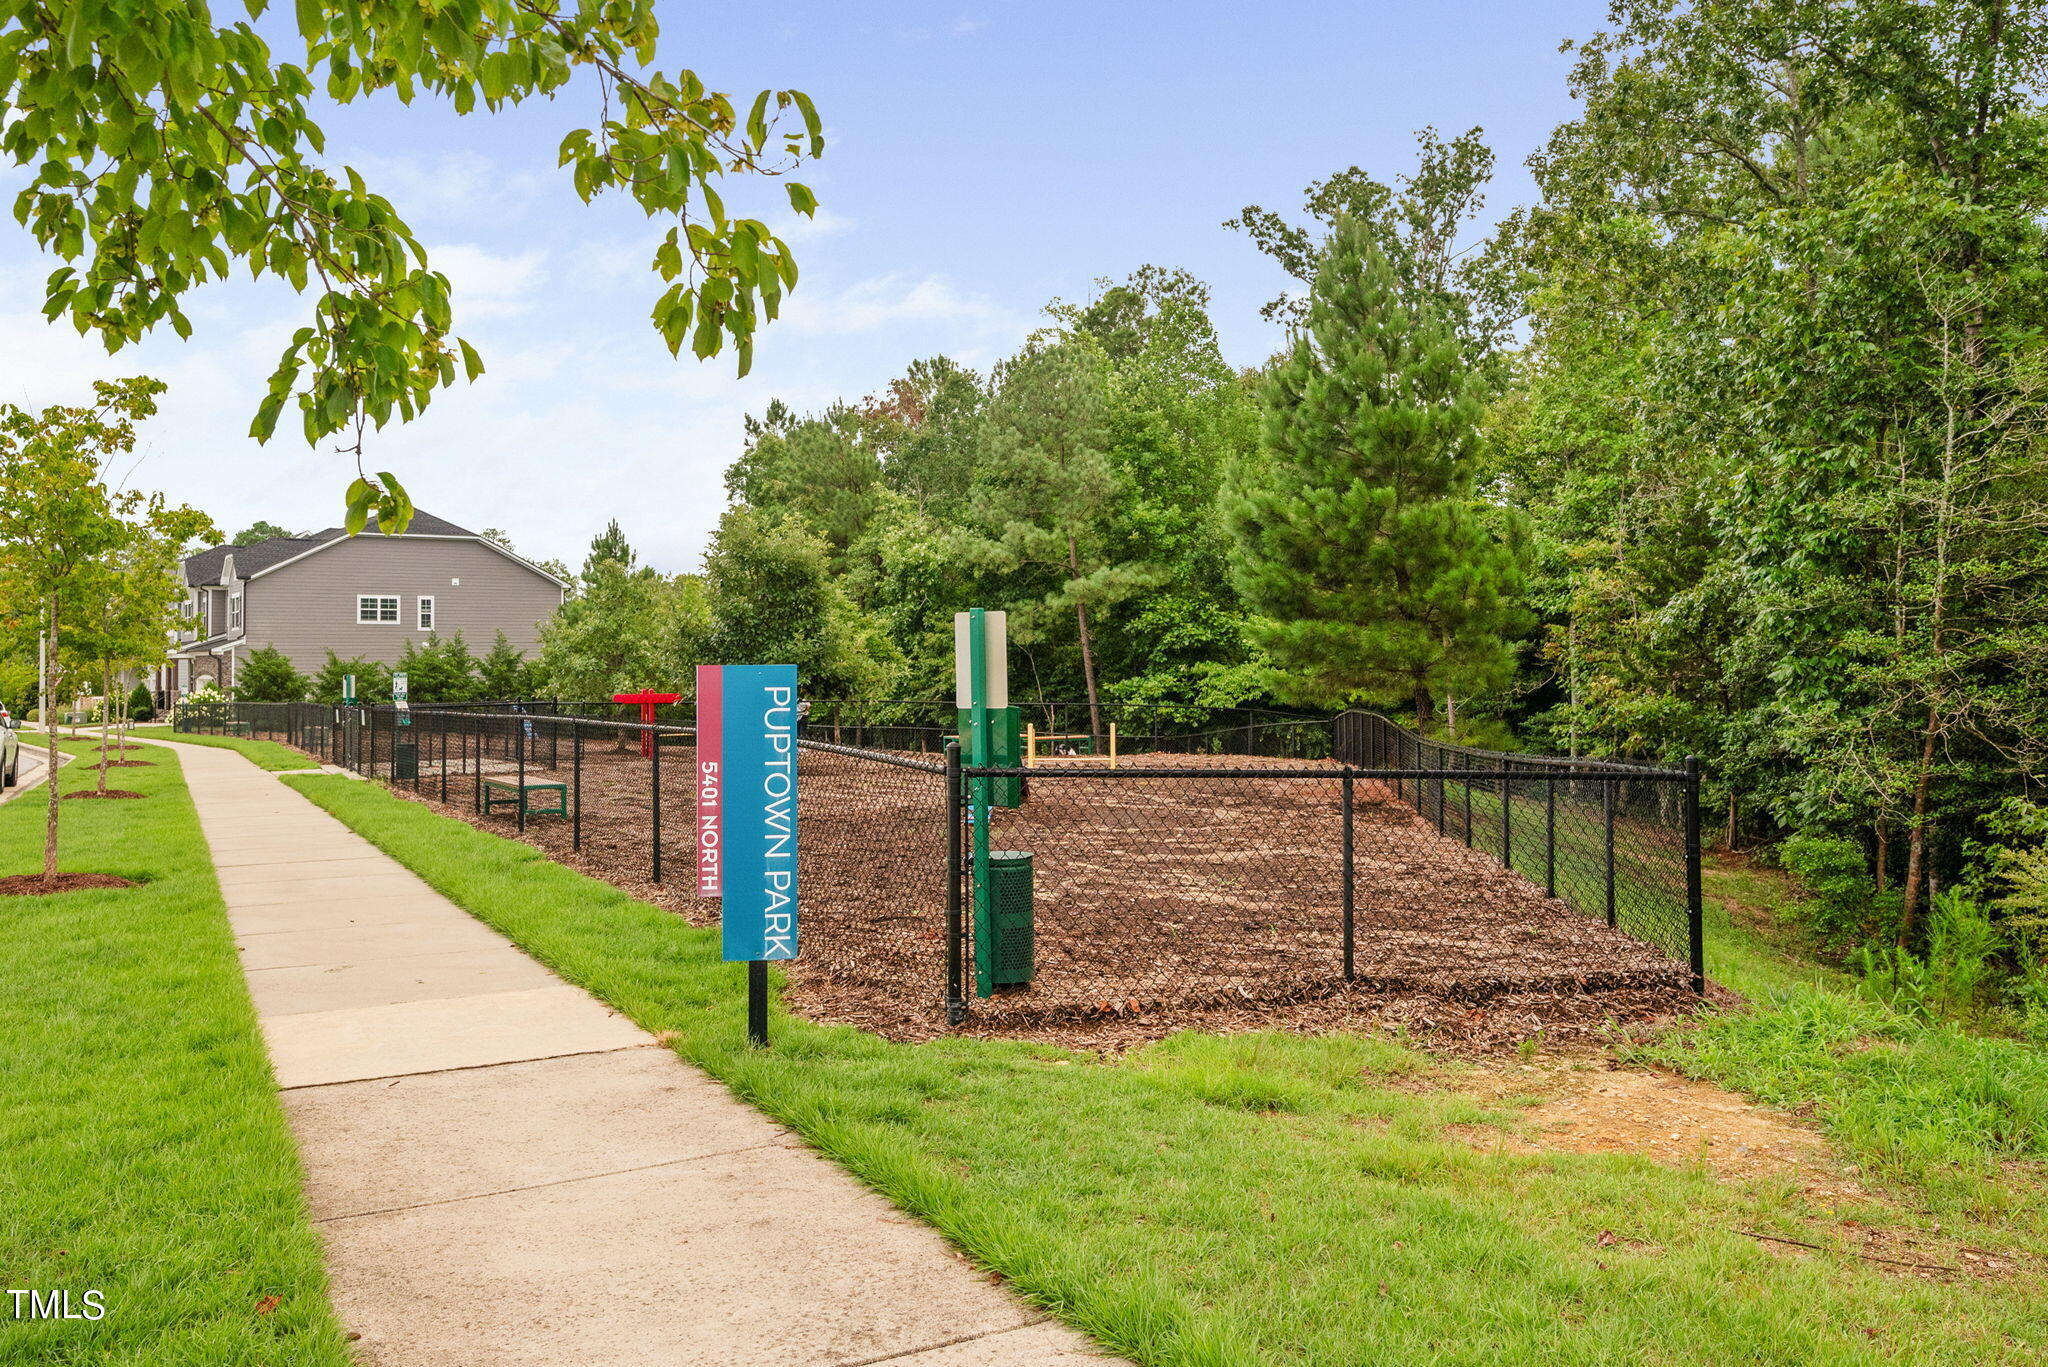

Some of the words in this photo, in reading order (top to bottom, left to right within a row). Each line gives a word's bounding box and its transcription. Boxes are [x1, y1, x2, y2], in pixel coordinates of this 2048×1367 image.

[701, 761, 718, 807] 5401
[764, 686, 791, 858] PUPTOWN
[701, 815, 718, 891] NORTH
[764, 871, 791, 958] PARK
